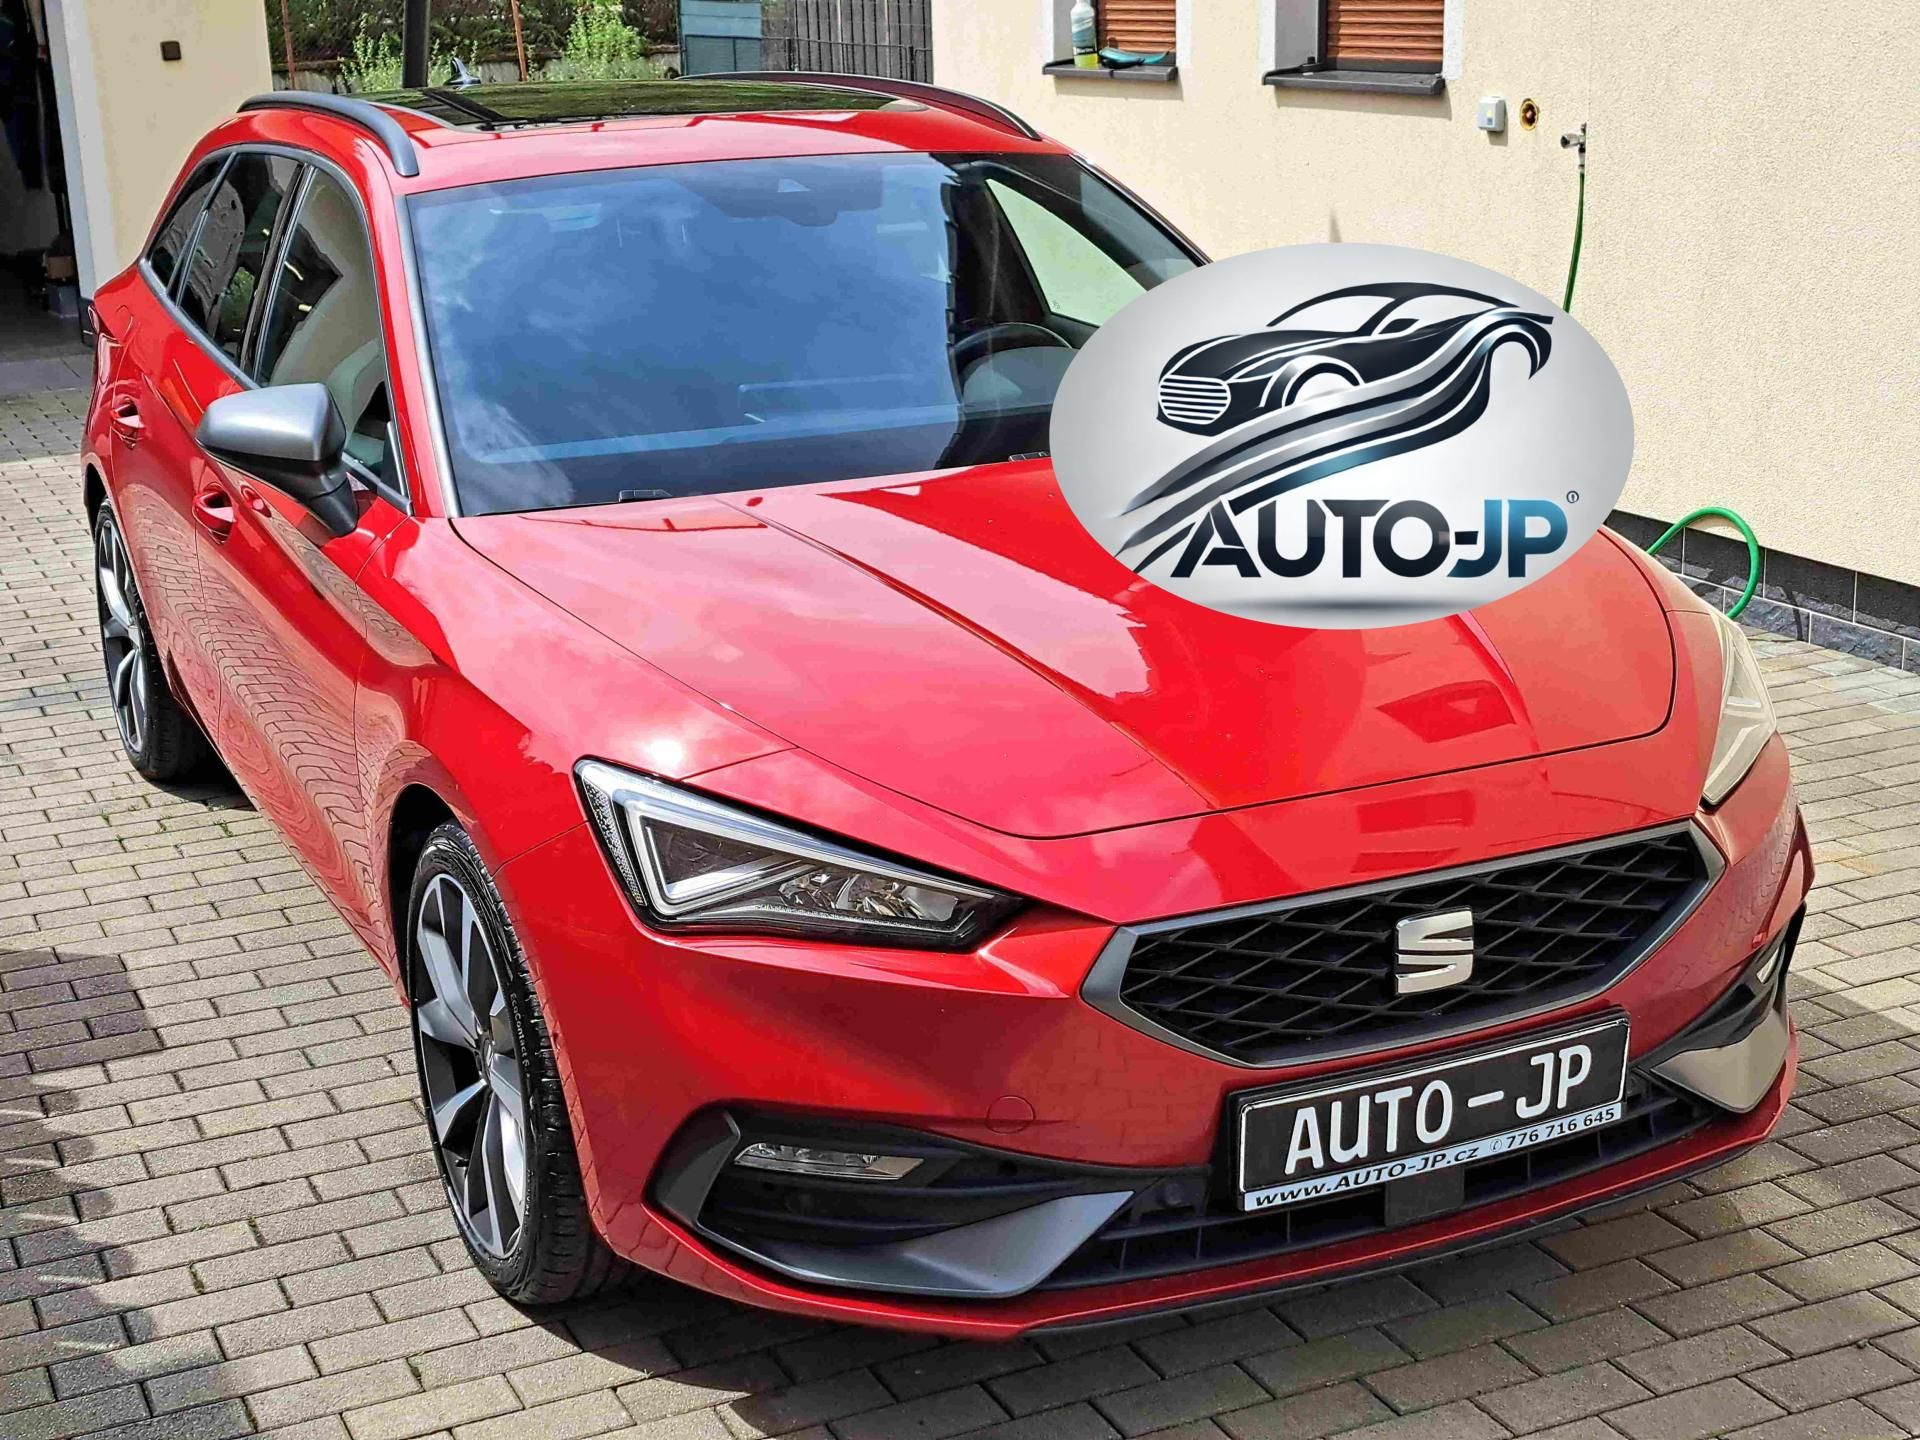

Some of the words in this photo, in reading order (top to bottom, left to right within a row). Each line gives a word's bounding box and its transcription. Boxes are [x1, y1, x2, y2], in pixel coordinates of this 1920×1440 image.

[509, 992, 528, 1058] EcoContact
[1255, 1146, 1479, 1207] www.AUTO-JP.cz
[1505, 1128, 1539, 1149] 776
[1545, 1118, 1577, 1140] 716
[1583, 1107, 1615, 1131] 645
